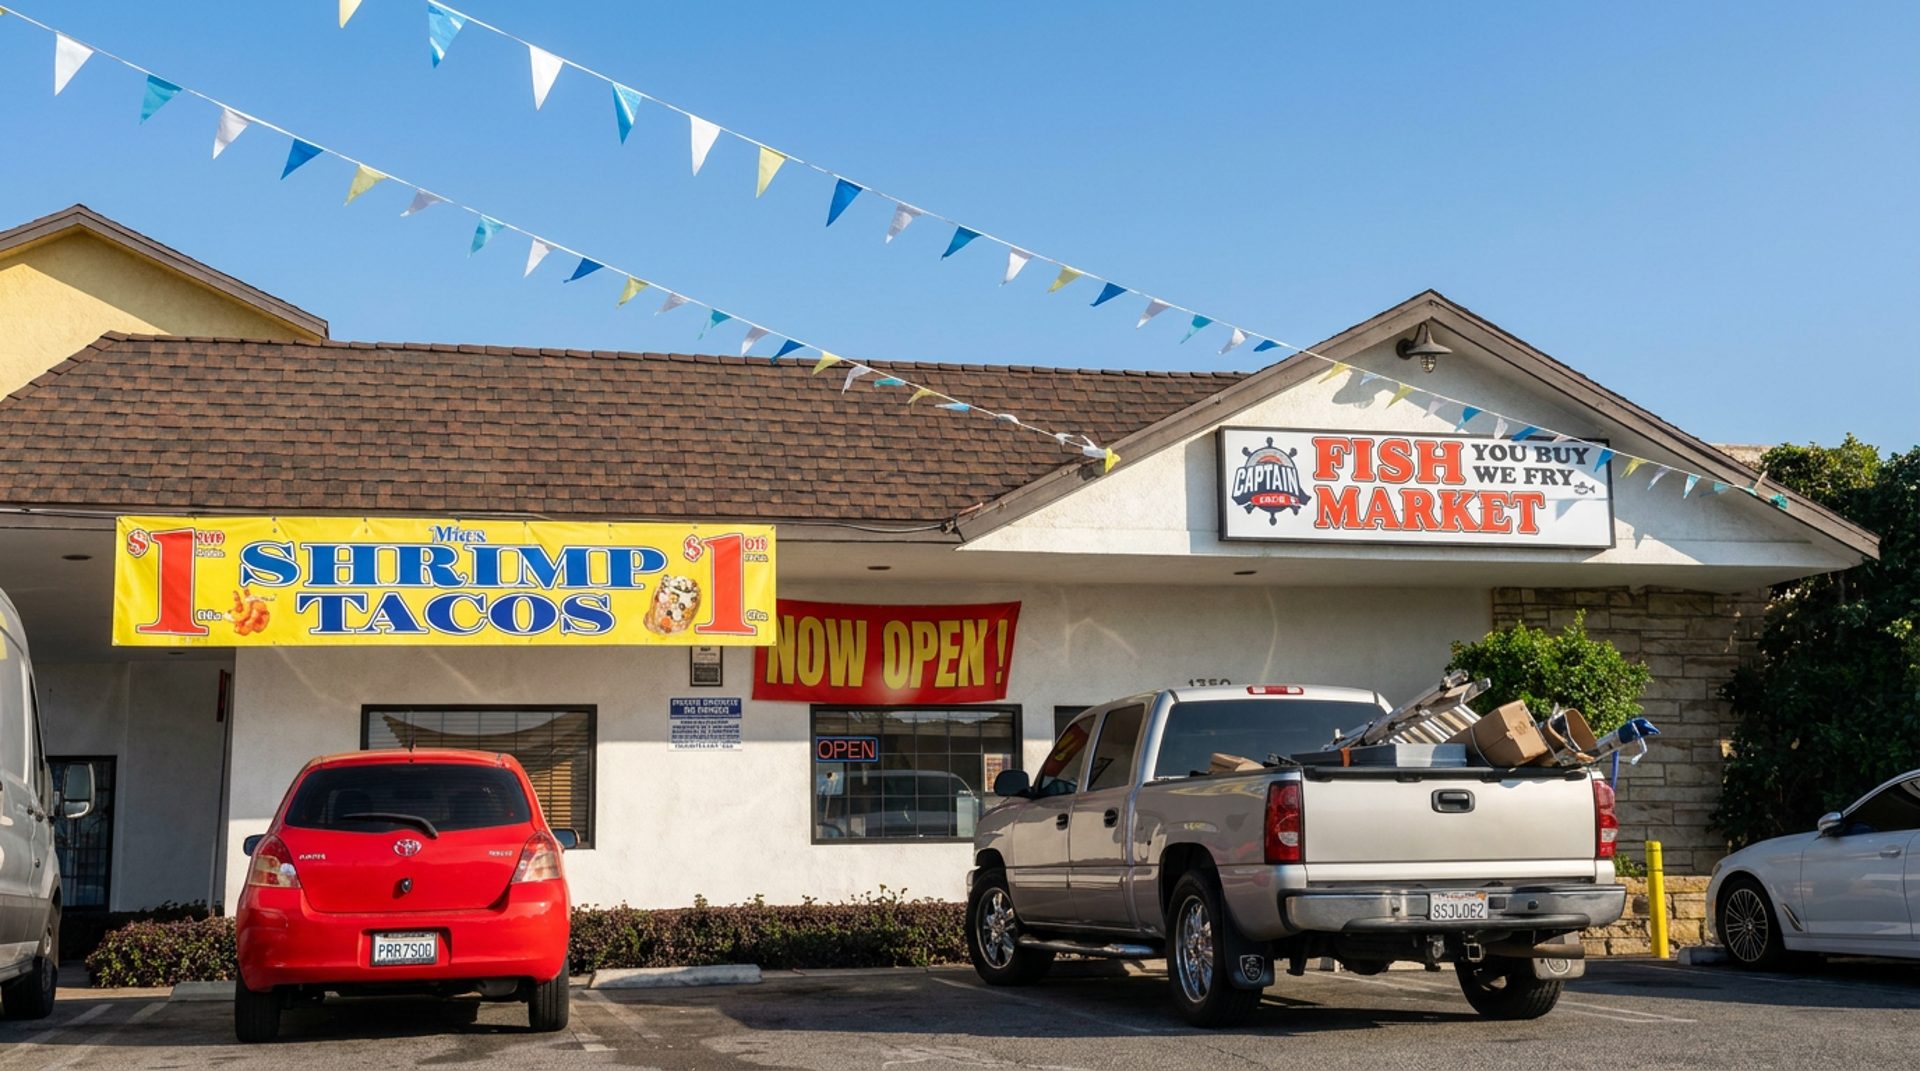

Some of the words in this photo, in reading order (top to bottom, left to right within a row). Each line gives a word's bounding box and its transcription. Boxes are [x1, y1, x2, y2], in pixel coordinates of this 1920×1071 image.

[1312, 436, 1466, 485] FISH
[1471, 444, 1527, 462] YOU
[1534, 446, 1590, 465] BUY
[1473, 466, 1516, 484] WE
[1523, 467, 1575, 486] FRY
[1232, 463, 1300, 498] CAPTAIN
[1314, 485, 1546, 535] MARKET
[239, 541, 669, 590] SHRIMP
[296, 591, 616, 637] TACOS
[766, 614, 868, 688] NOW
[882, 617, 989, 691] OPEN
[818, 740, 875, 760] OPEN
